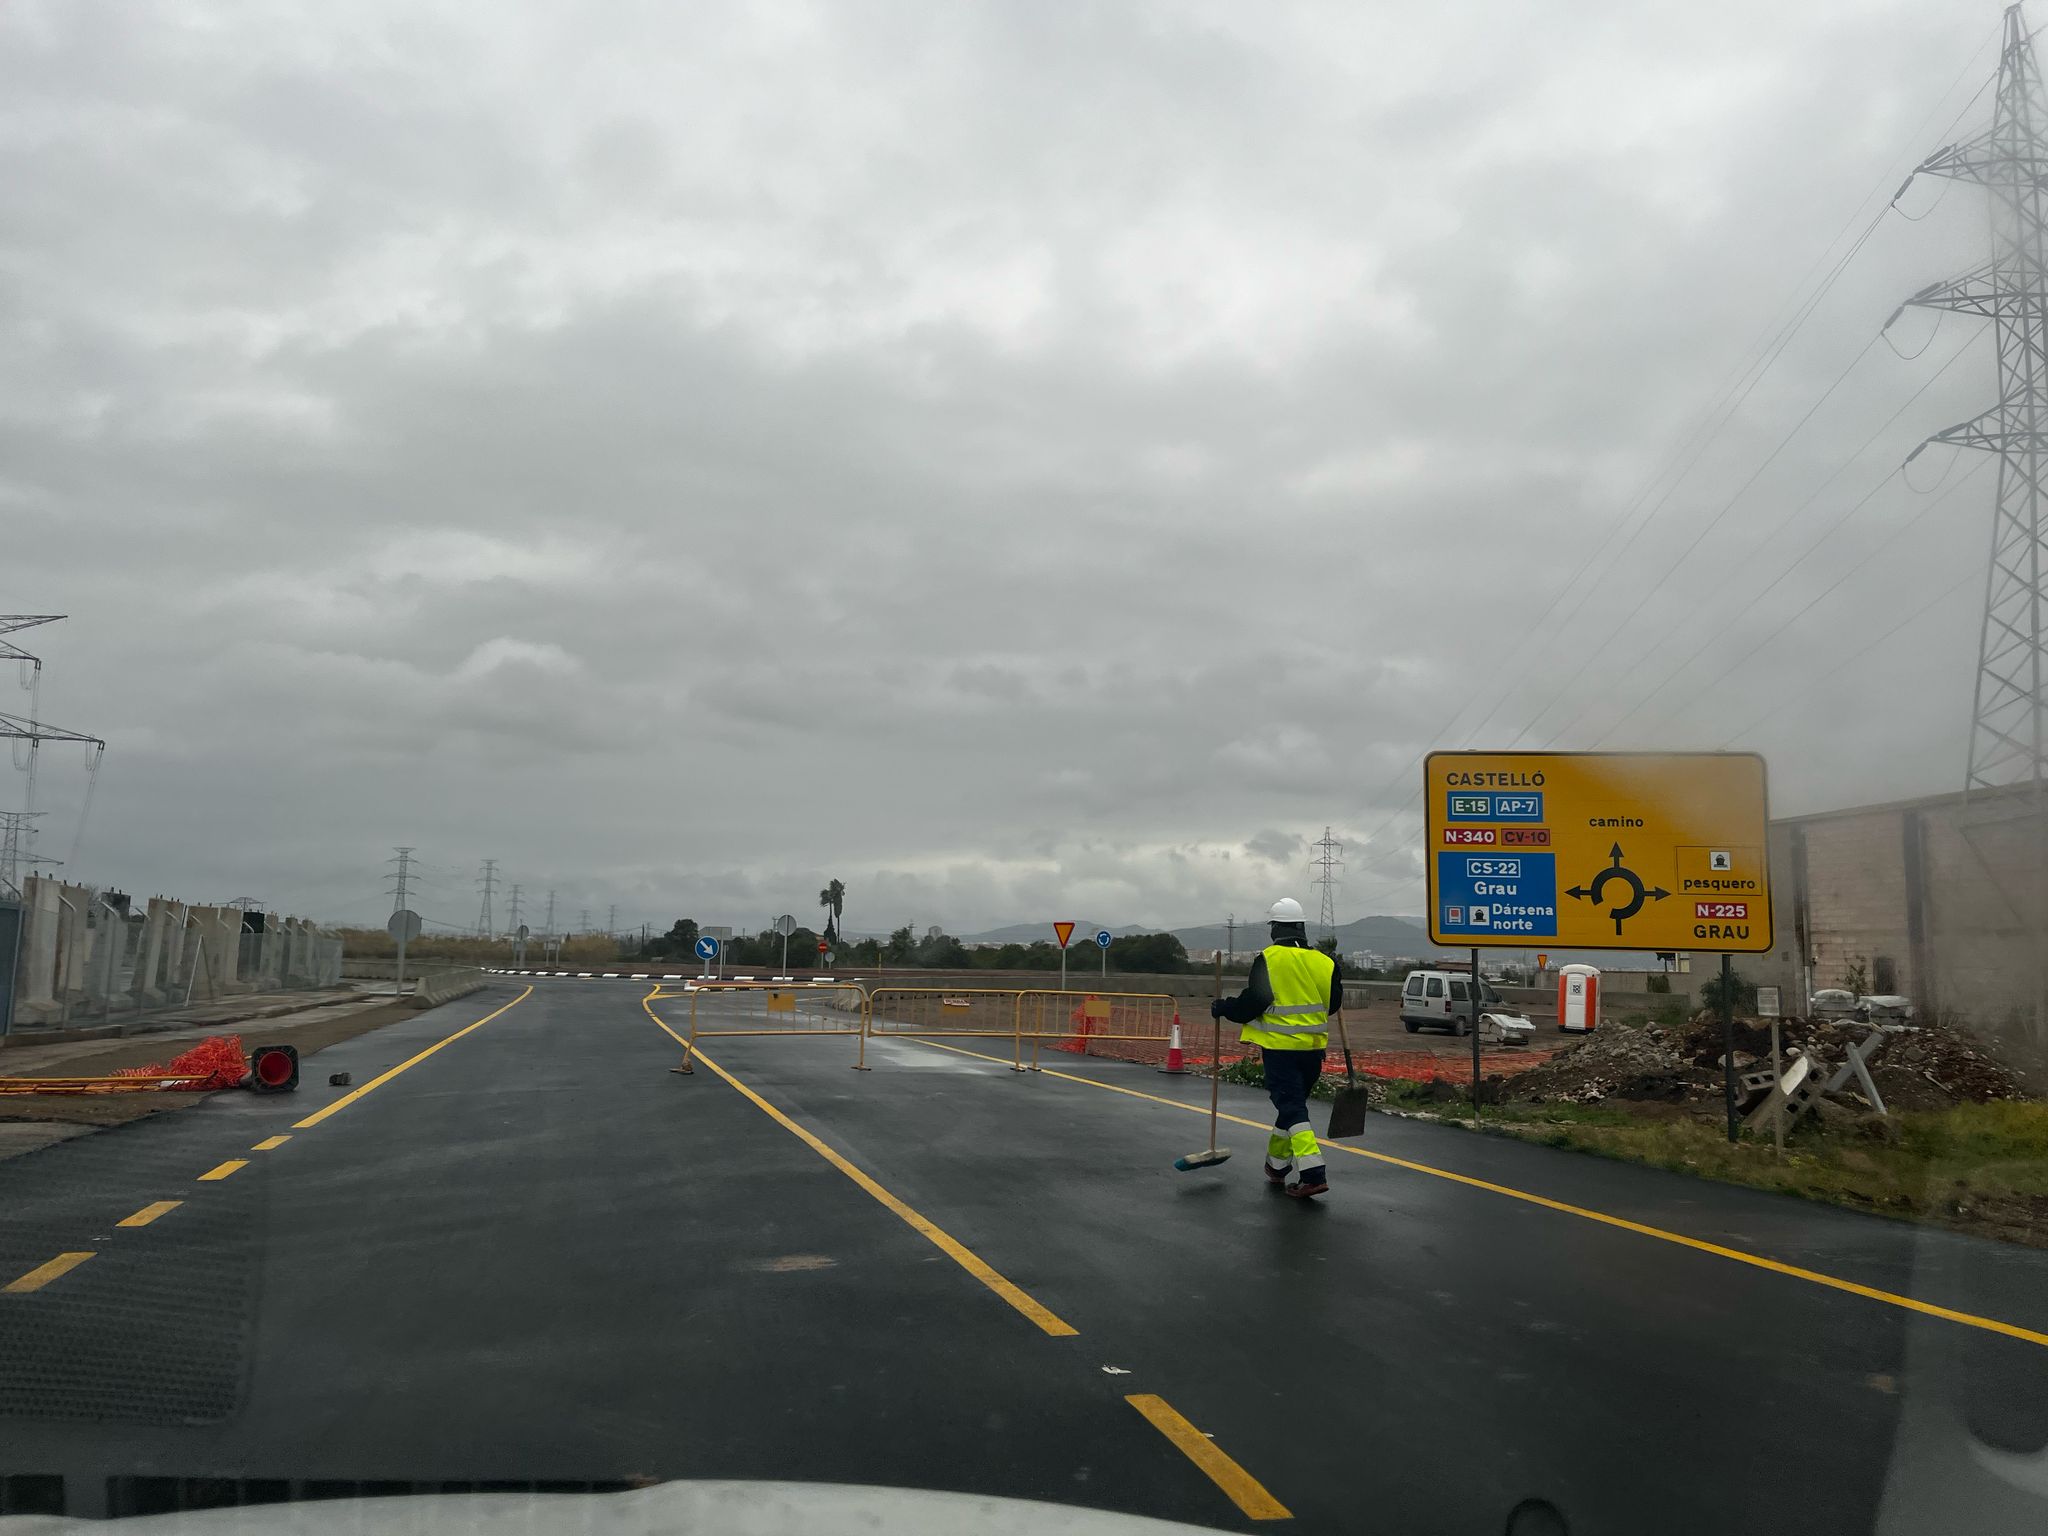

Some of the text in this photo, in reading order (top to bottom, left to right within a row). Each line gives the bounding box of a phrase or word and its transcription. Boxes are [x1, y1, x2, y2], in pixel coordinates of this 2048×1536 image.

[1446, 770, 1546, 787] CASTELLÓ
[1454, 801, 1535, 814] E-15 AP-7
[1588, 816, 1644, 829] camino
[1444, 831, 1548, 844] N-340 CV-10
[1469, 863, 1518, 875] CS-22
[1473, 882, 1518, 896] Grau
[1683, 878, 1756, 892] pesquero
[1491, 904, 1554, 917] Dársena
[1696, 905, 1746, 918] N-225
[1492, 920, 1534, 932] norte
[1693, 925, 1750, 940] GRAU
